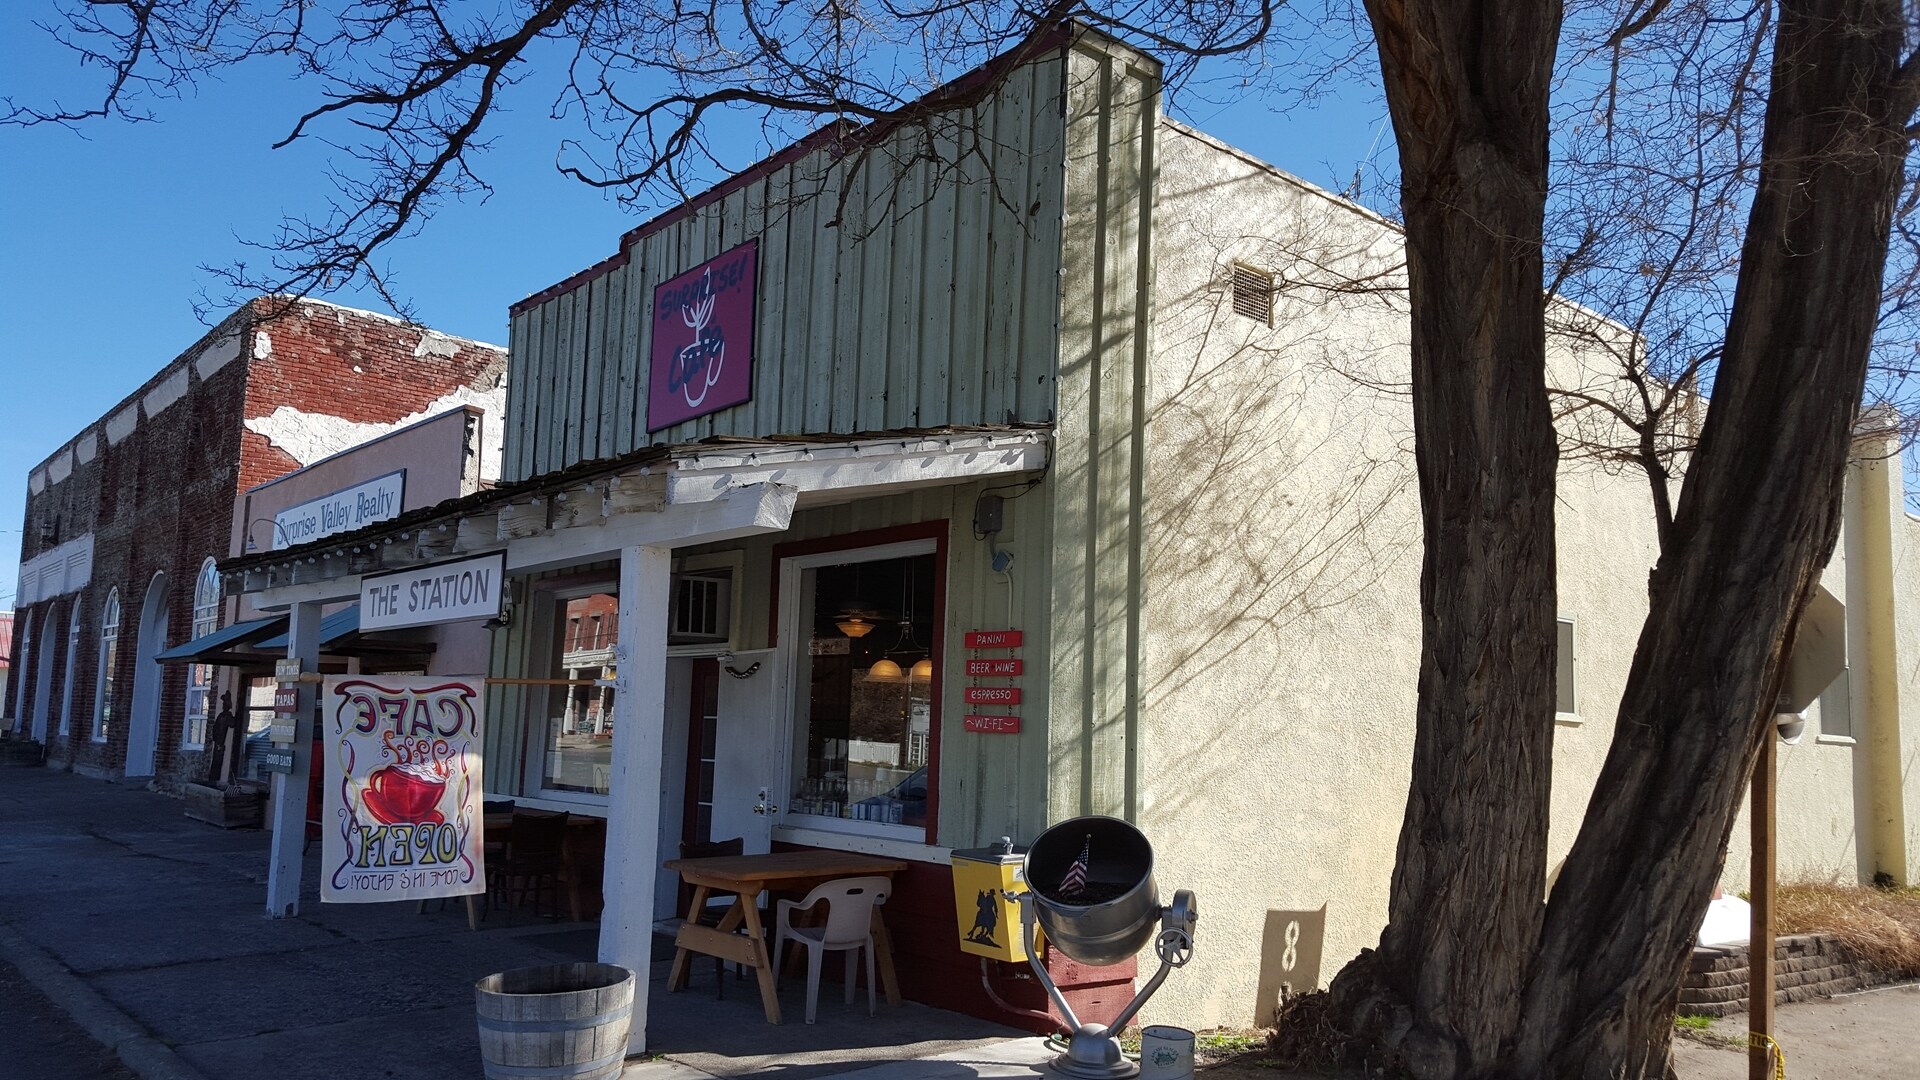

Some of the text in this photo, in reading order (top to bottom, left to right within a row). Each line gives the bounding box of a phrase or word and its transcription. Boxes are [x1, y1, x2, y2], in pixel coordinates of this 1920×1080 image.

[277, 486, 395, 546] Surprise Valley Realty
[369, 568, 490, 618] THE STATION
[976, 634, 1006, 645] PANINI
[970, 661, 1015, 674] BEER WINE
[275, 693, 295, 707] TAPAS
[266, 753, 292, 767] GOOD EATS
